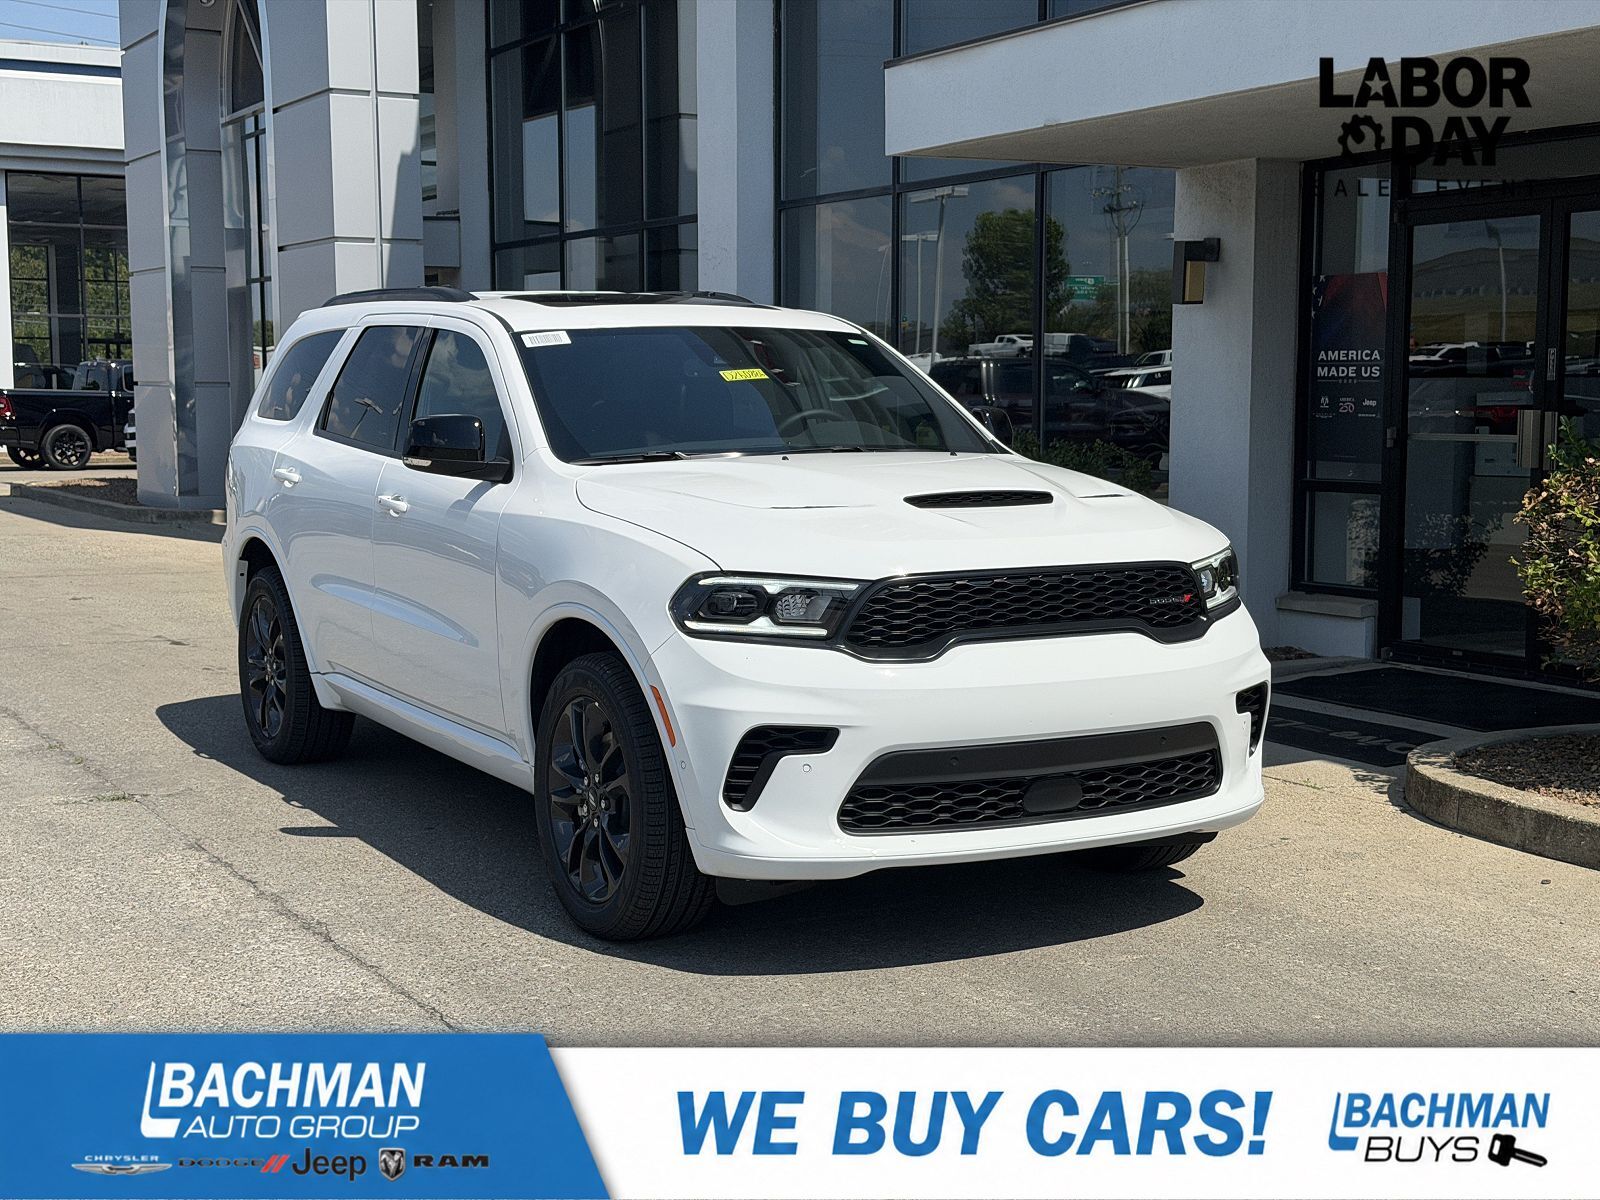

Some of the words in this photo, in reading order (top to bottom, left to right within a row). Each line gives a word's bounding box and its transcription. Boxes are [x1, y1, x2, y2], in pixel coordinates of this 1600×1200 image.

[1318, 350, 1381, 361] AMERICA
[1317, 366, 1357, 377] MADE
[1361, 366, 1380, 377] US
[1362, 398, 1377, 407] Jeep
